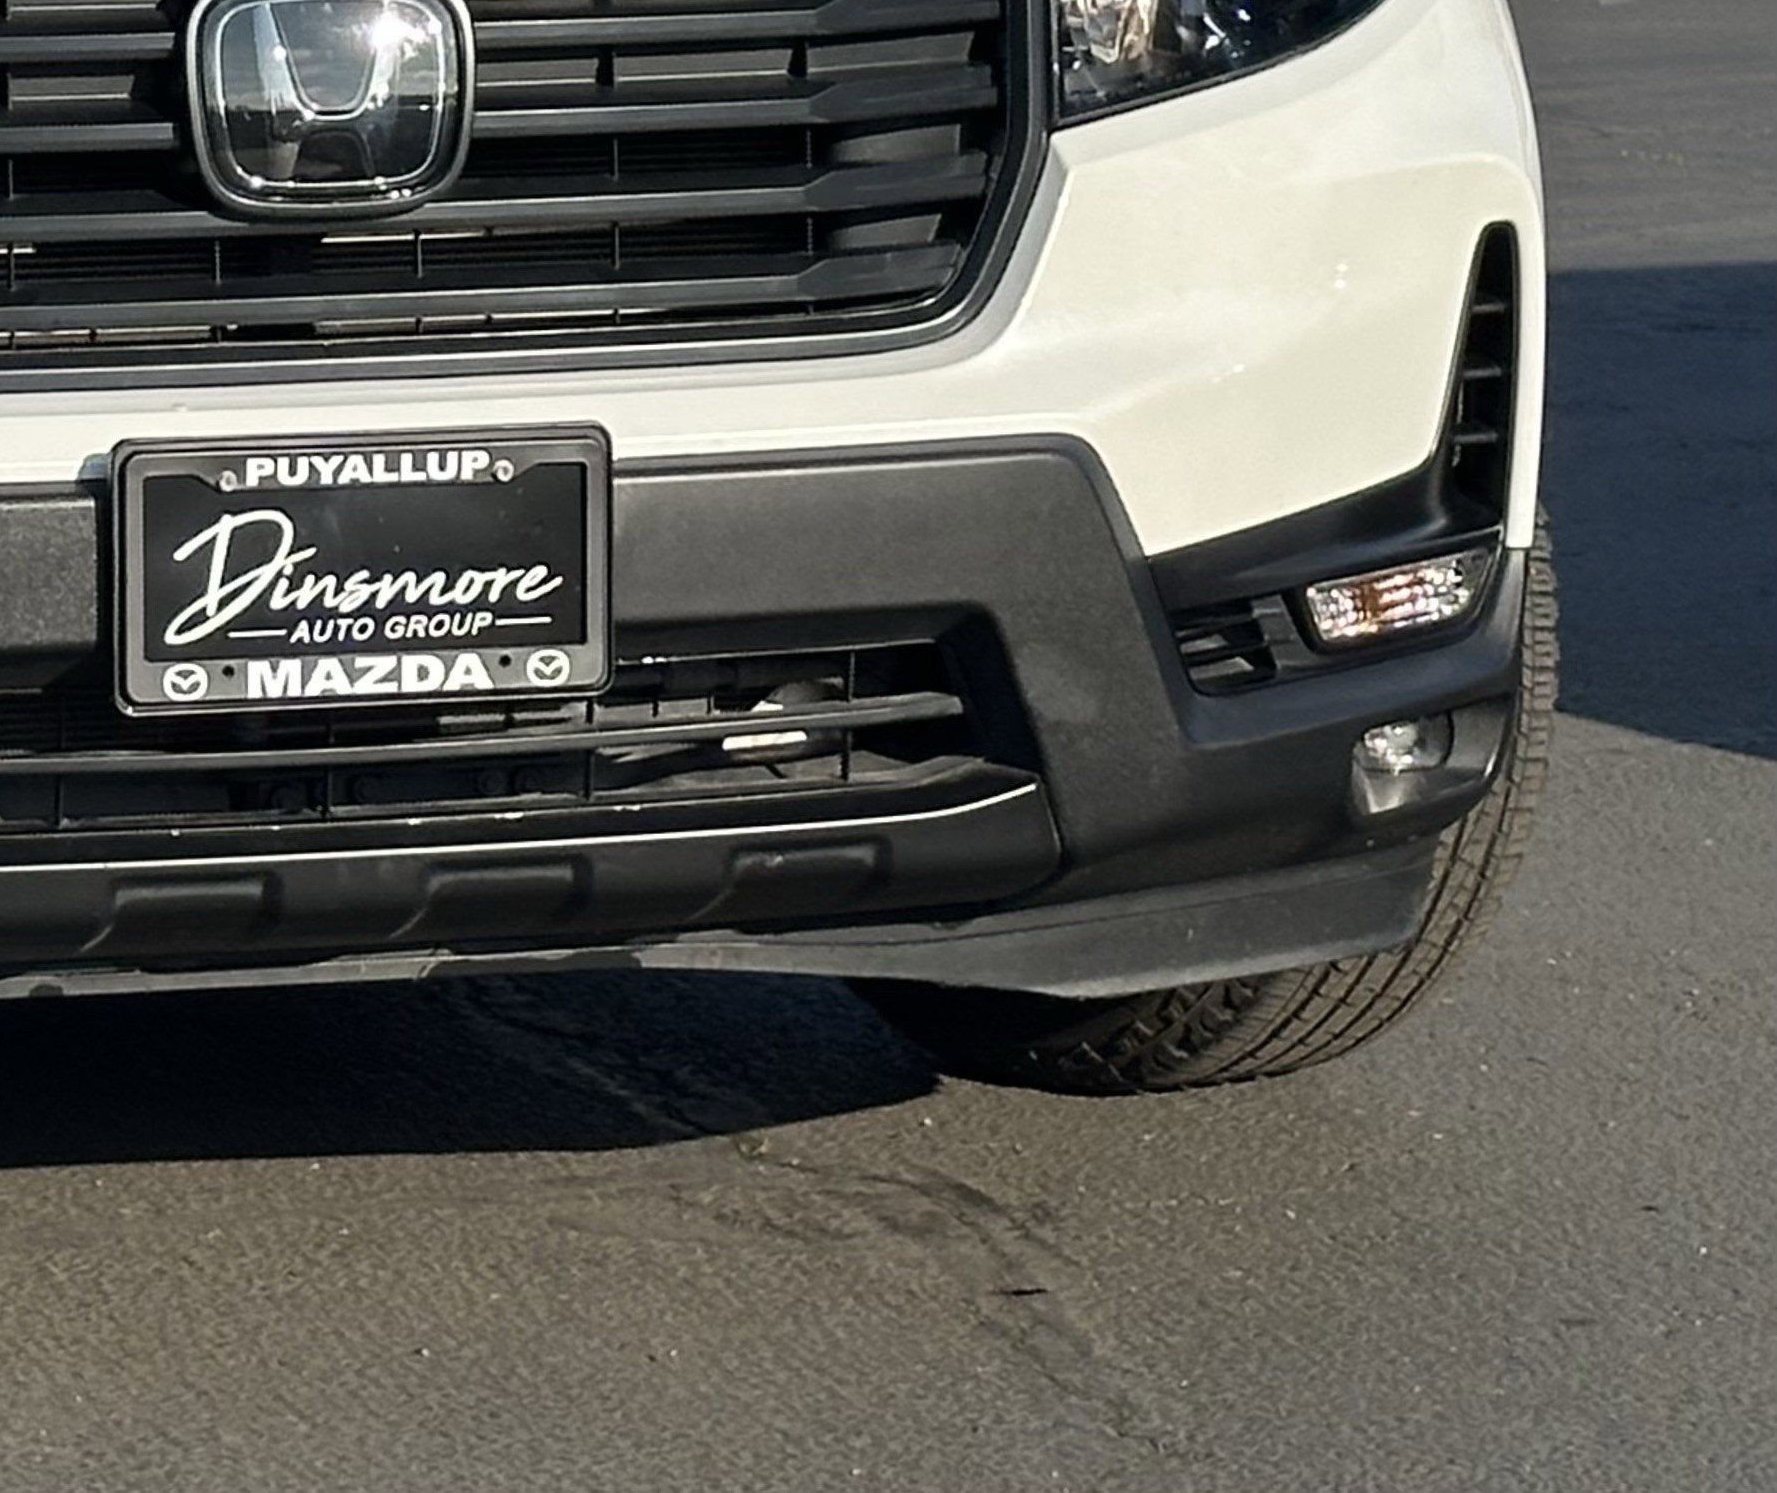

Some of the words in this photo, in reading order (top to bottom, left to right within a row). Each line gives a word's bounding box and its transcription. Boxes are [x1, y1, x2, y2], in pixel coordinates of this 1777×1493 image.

[245, 450, 492, 487] PUYALLUP
[164, 508, 563, 646] Dinsmore
[289, 615, 376, 644] AUTO
[383, 612, 494, 641] GROUP
[246, 652, 495, 699] MAZDA
